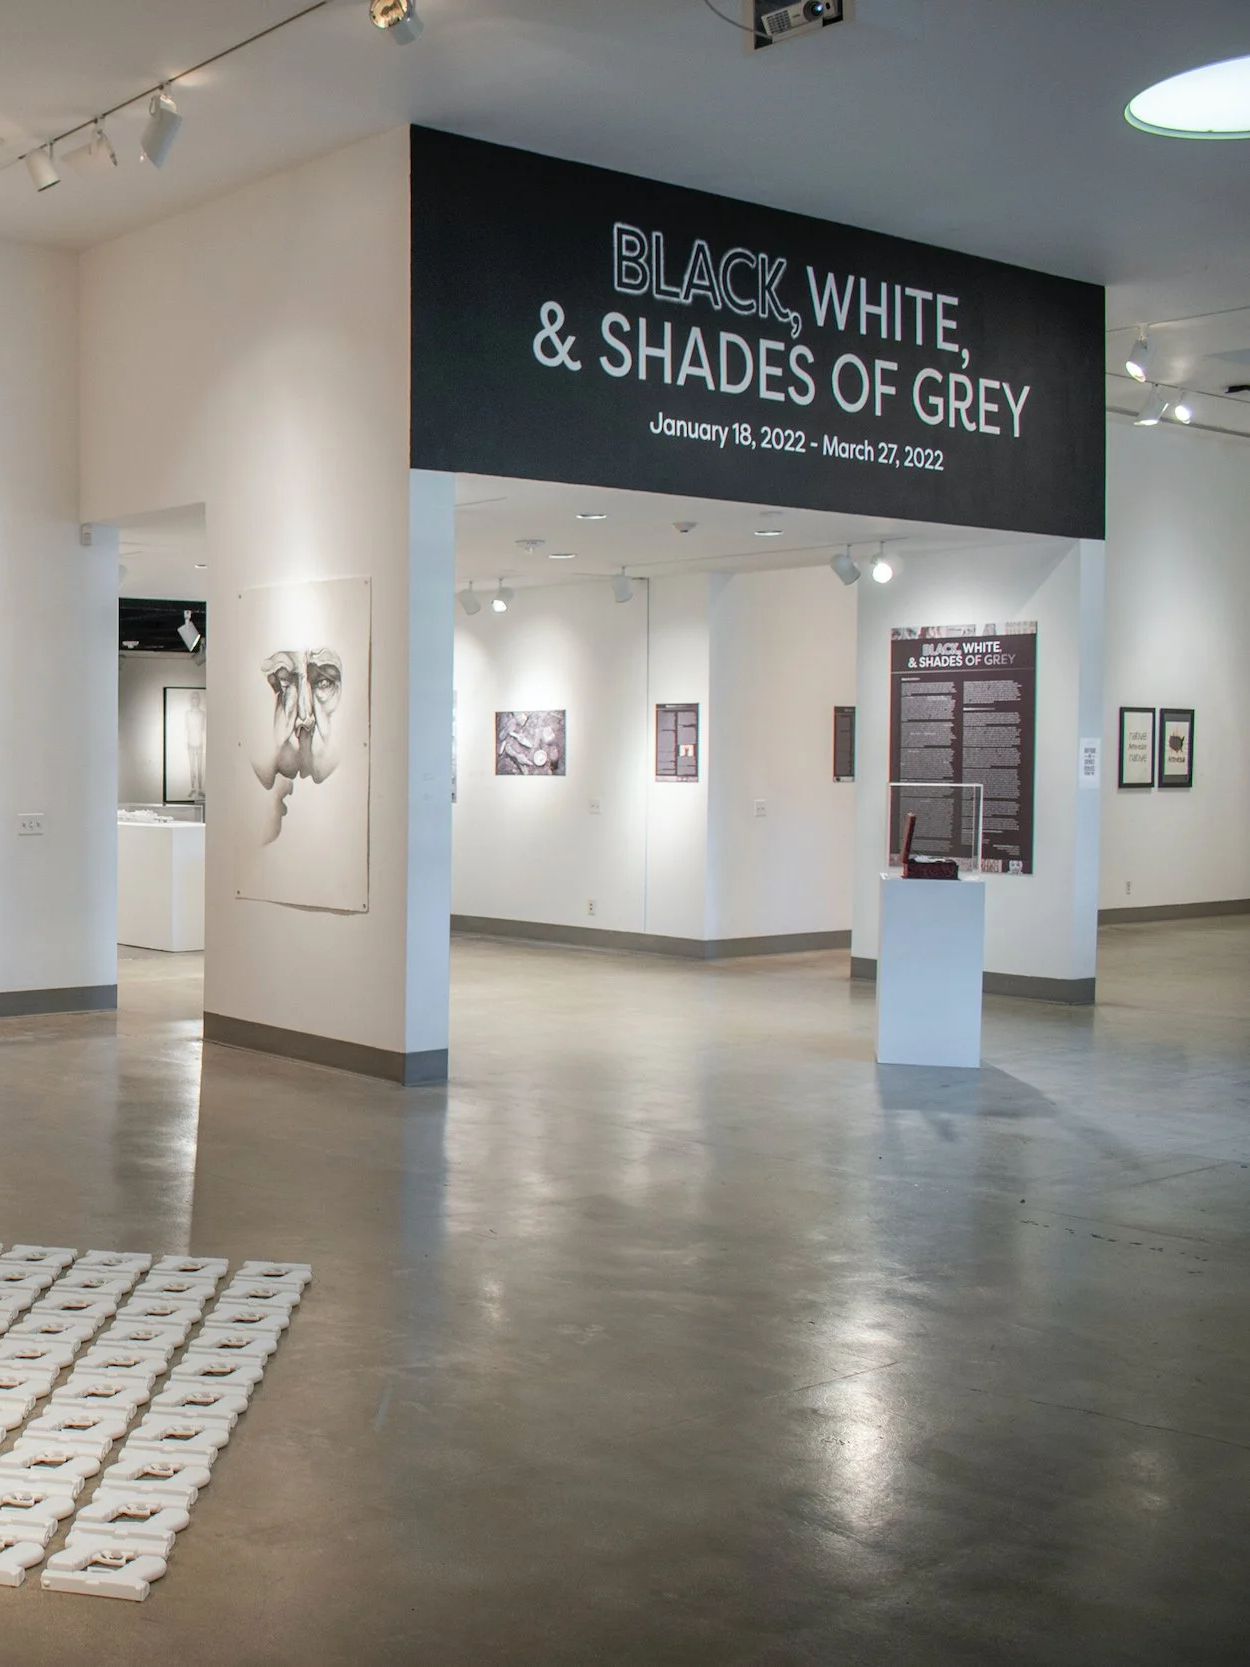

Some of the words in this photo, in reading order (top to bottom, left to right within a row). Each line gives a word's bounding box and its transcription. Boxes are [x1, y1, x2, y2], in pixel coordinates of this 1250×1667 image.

[613, 222, 802, 339] BLACK,
[806, 266, 969, 369] WHITE,
[533, 301, 582, 371] &
[600, 311, 815, 406] SHADES
[832, 353, 898, 417] OF
[912, 367, 1030, 438] GREY
[650, 412, 728, 448] January
[732, 423, 756, 449] 18,
[761, 426, 806, 453] 2022
[823, 434, 874, 462] March
[878, 442, 900, 468] 27,
[904, 447, 944, 471] 2022
[908, 657, 917, 668] &
[919, 655, 963, 668] SHADES
[965, 654, 982, 666] OF
[984, 653, 1016, 666] GREY
